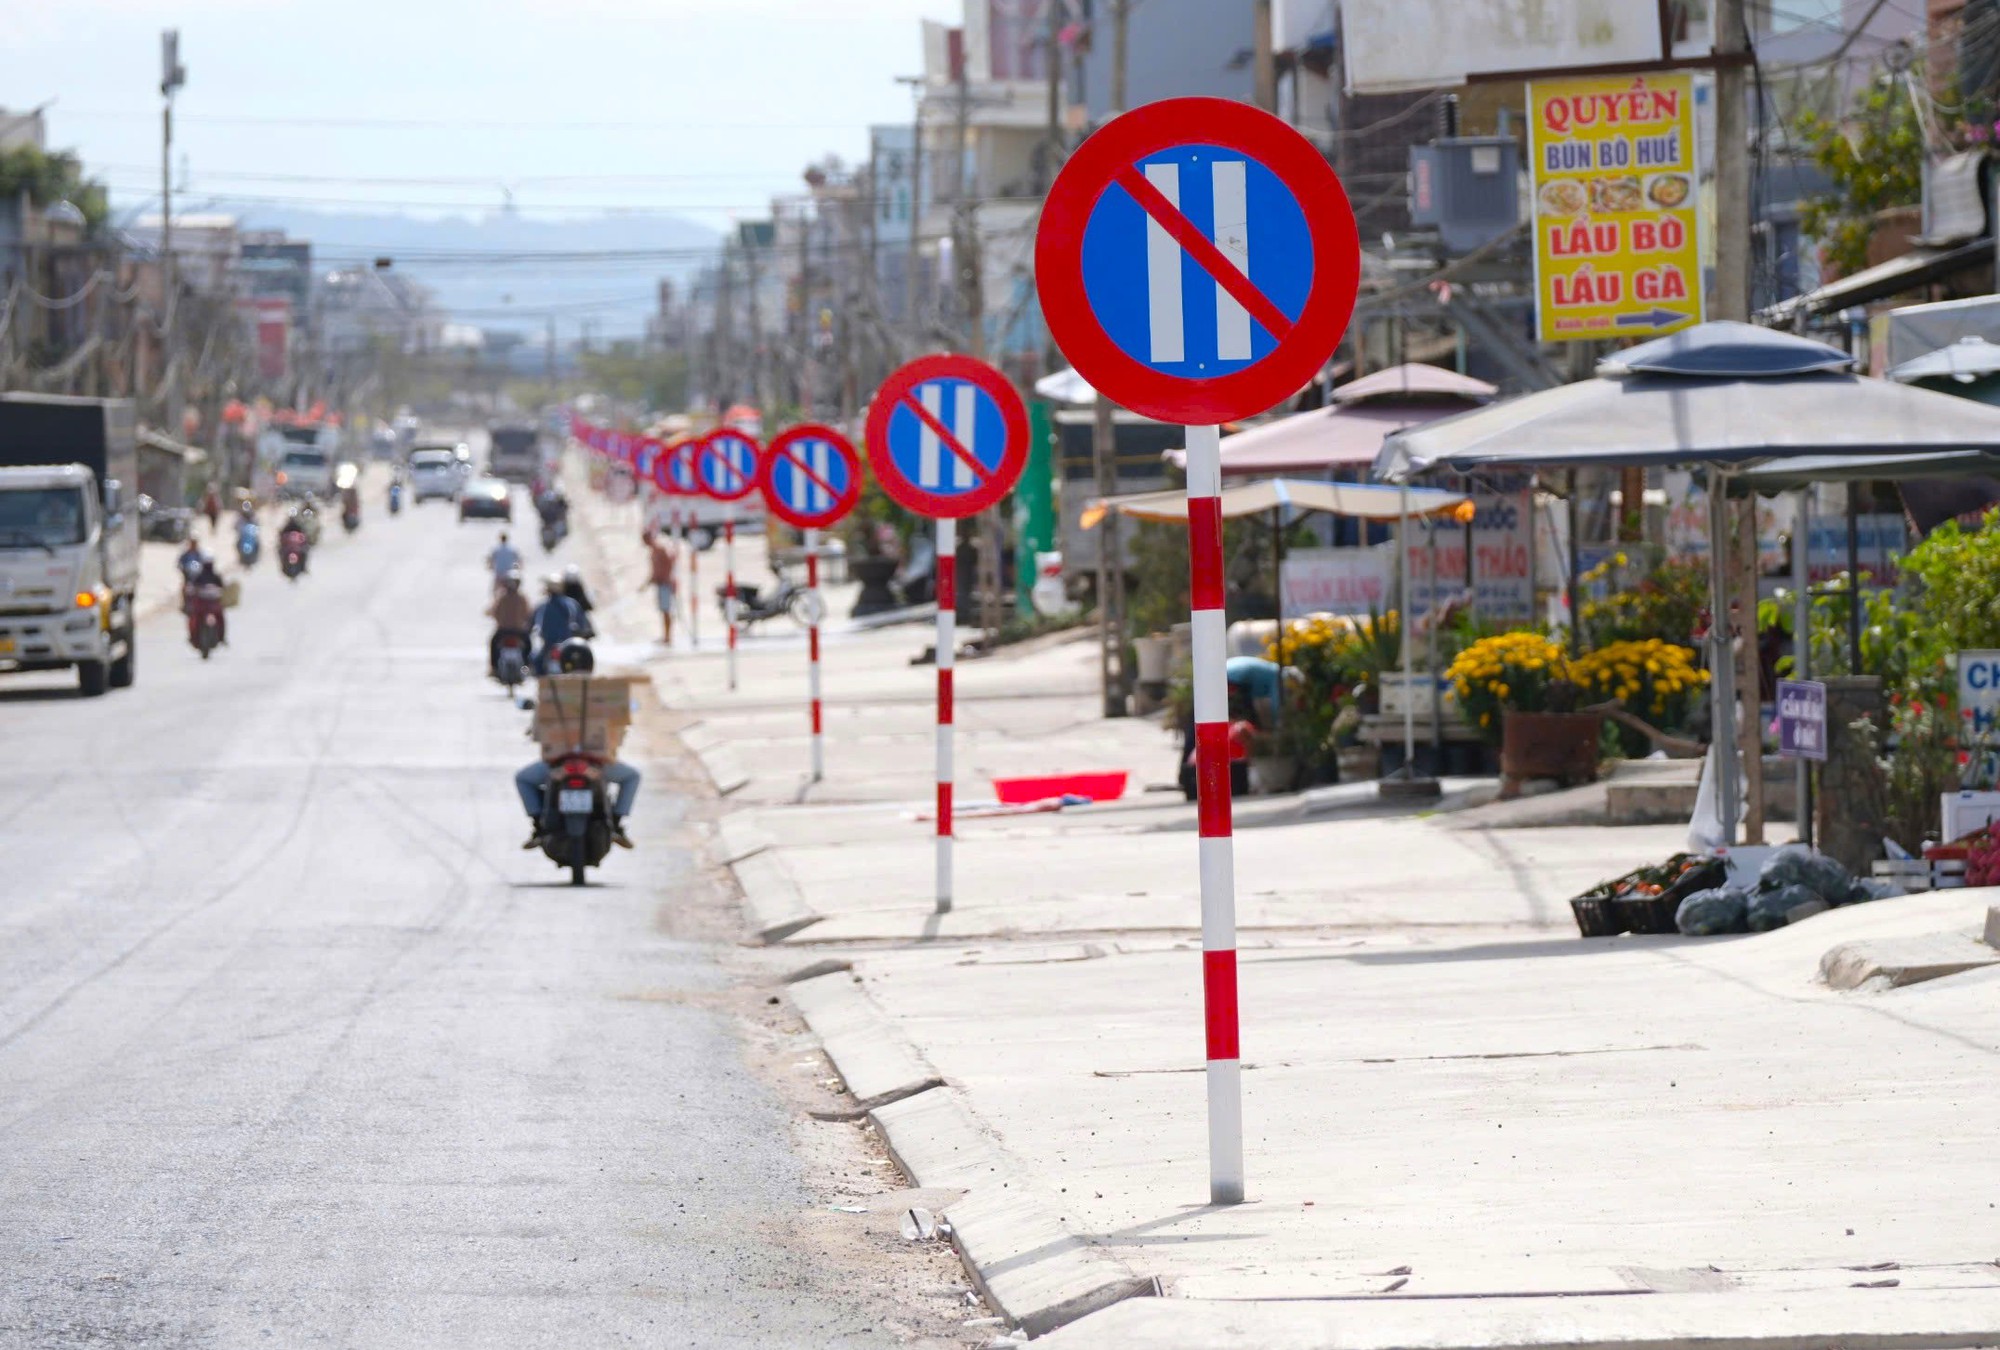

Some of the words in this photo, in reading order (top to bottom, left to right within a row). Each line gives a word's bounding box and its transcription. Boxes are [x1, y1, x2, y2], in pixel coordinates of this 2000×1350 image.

[1546, 139, 1592, 171] BÚN
[1599, 135, 1629, 168] BÒ
[1637, 127, 1680, 165] HUẾ
[1632, 216, 1684, 251] BÒ
[1635, 264, 1687, 301] GÀ
